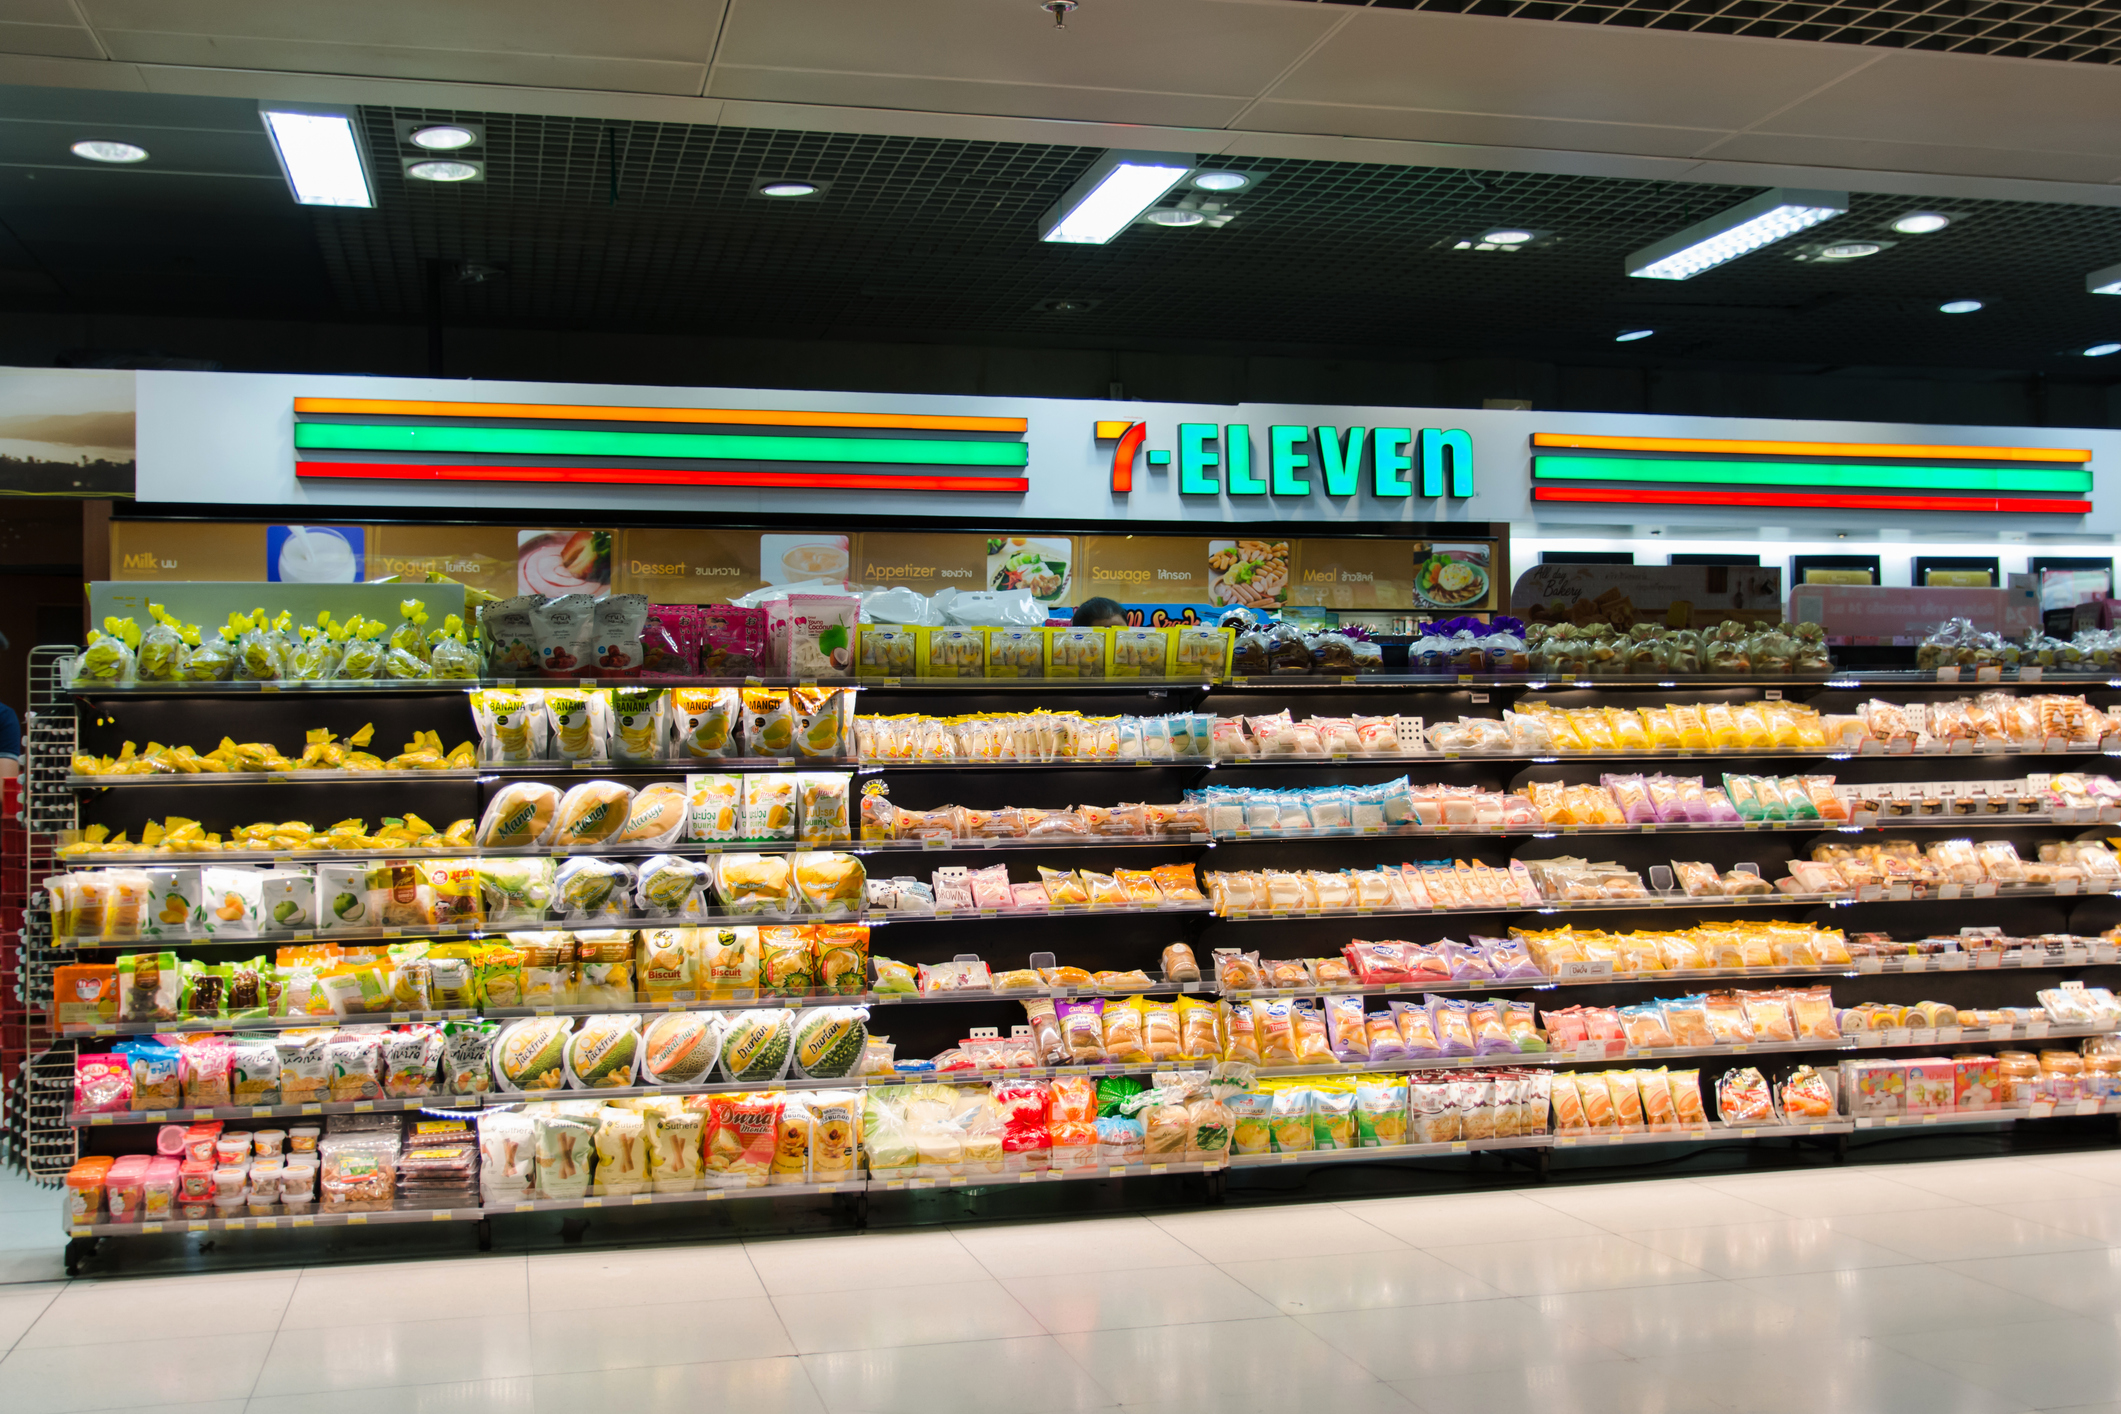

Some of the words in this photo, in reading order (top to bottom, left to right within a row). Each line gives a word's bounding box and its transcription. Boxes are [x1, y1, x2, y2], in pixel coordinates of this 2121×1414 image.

[124, 552, 158, 569] Milk
[161, 559, 177, 569] นม
[383, 558, 437, 575] Yogurt
[631, 561, 685, 575] Dessert
[695, 566, 740, 576] ขนมหวาน
[865, 563, 936, 581] Appetizer
[941, 567, 973, 578] ของว่าง
[1092, 566, 1151, 584] Sausage
[1157, 568, 1191, 580] ไส้กรอก
[1534, 567, 1550, 580] All
[1551, 567, 1567, 582] day
[1303, 568, 1337, 583] Meal
[1543, 580, 1582, 604] Bakery
[490, 702, 525, 711] BANANA
[617, 702, 650, 712] BANANA
[683, 701, 714, 711] MANGO
[749, 700, 780, 710] MANGO
[648, 969, 681, 979] Biscuit
[710, 968, 742, 977] Biscuit
[737, 1025, 768, 1060] Durian
[809, 1021, 841, 1055] Durian
[514, 1031, 549, 1069] Jackfruit
[585, 1029, 619, 1066] Jackfruit
[719, 1104, 776, 1124] Duria
[614, 1121, 643, 1129] Suther
[665, 1122, 699, 1130] Suthera
